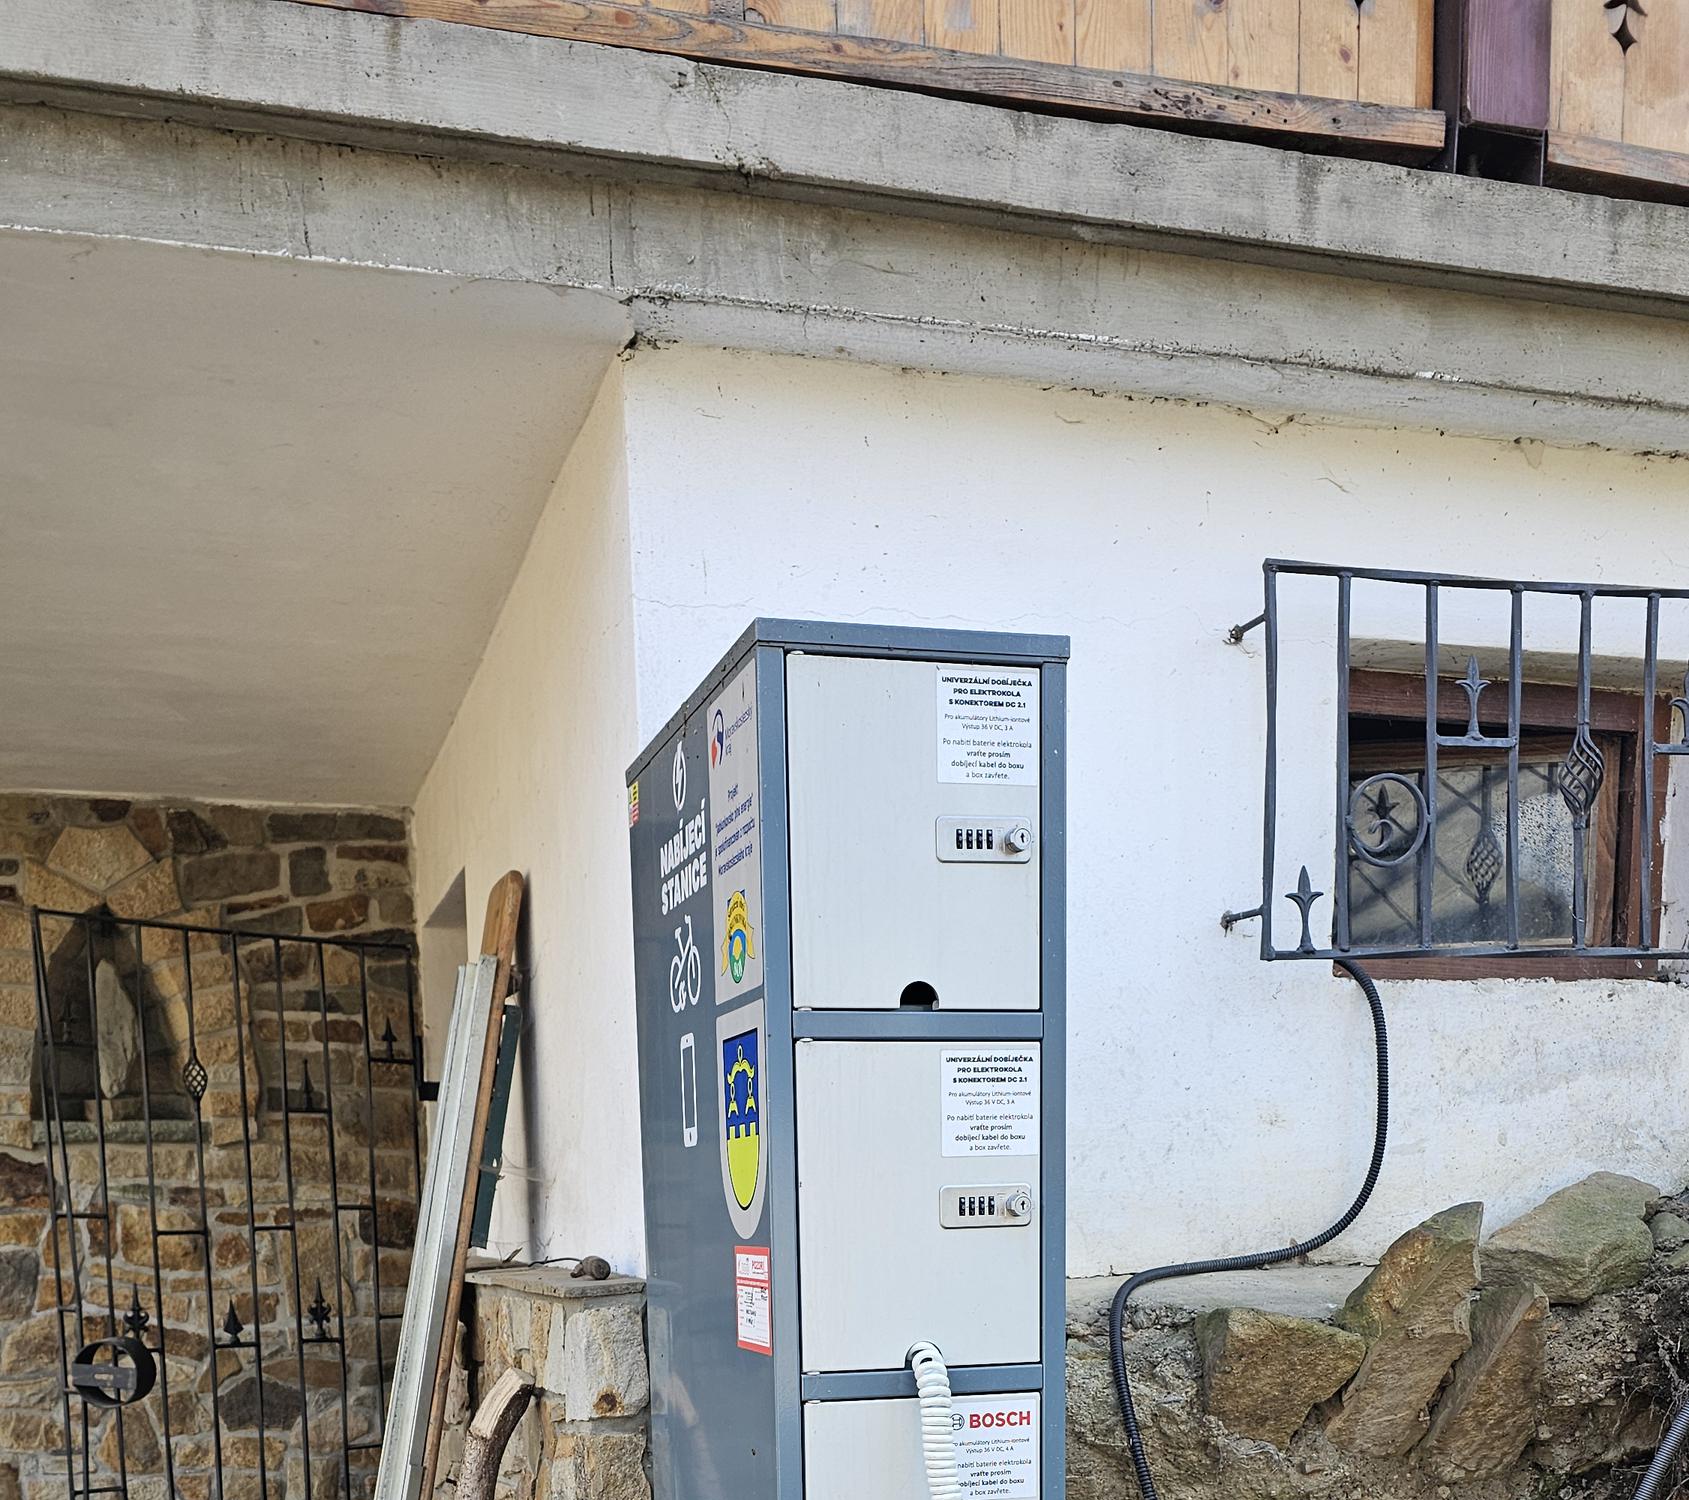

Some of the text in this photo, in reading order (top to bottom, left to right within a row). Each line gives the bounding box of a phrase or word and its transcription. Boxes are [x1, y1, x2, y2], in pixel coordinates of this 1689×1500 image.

[942, 676, 1032, 687] UNIVERZÁLNÍ DOBÍJEČKA
[970, 689, 1021, 697] ELEKTROKOLA
[973, 738, 995, 747] baterie
[997, 739, 1032, 748] elektrokola
[988, 751, 1010, 759] prosím
[660, 798, 706, 878] NABÍJECÍ
[661, 852, 707, 916] STANICE
[969, 1411, 1030, 1428] BOSCH
